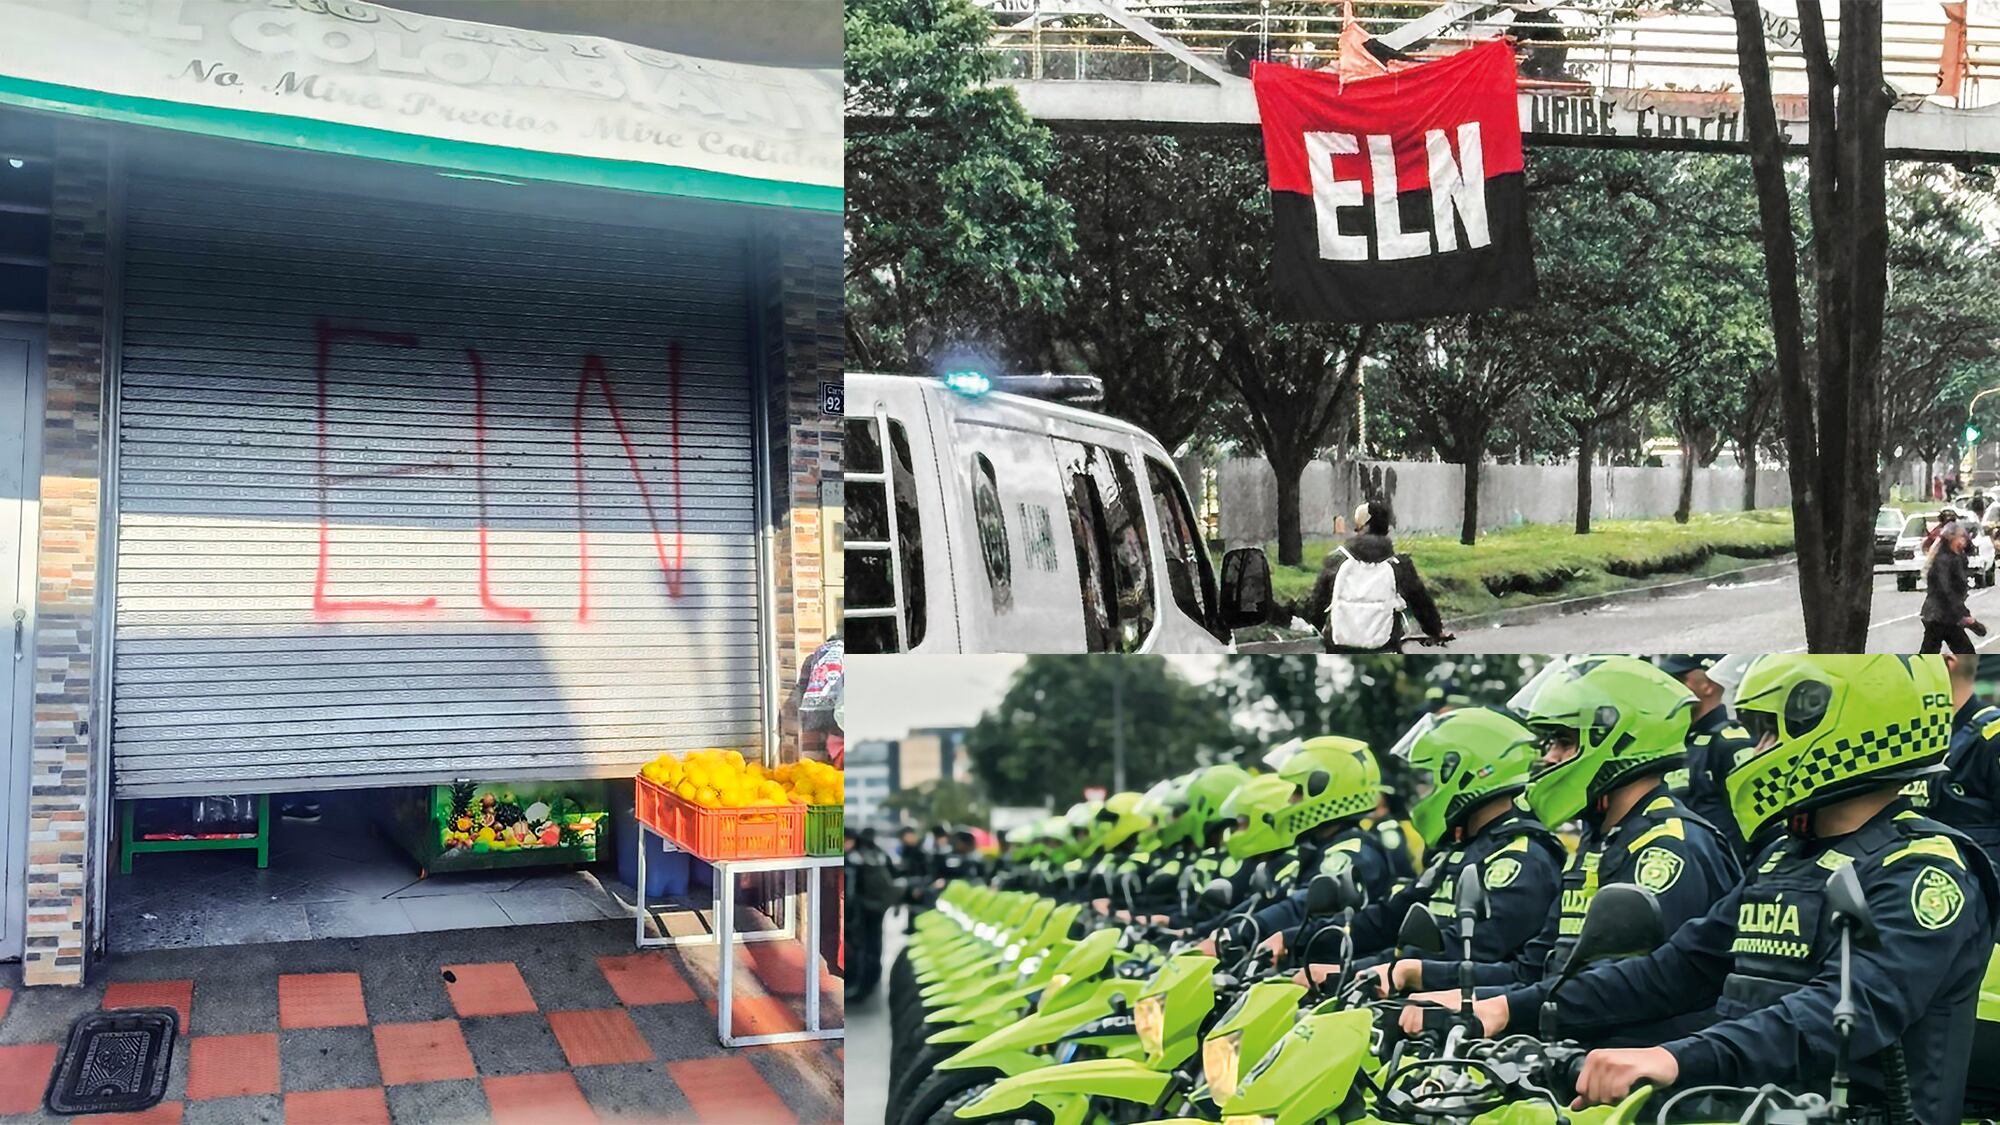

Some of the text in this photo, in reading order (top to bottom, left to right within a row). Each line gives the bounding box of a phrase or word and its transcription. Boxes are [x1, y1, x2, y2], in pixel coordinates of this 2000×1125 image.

[263, 70, 386, 111] Mire
[393, 91, 559, 135] Precios
[1532, 95, 1617, 135] URIBE
[1303, 121, 1491, 261] ELN
[827, 396, 841, 411] 92
[313, 318, 684, 625] ELN
[1737, 893, 1800, 936] OLICÍA
